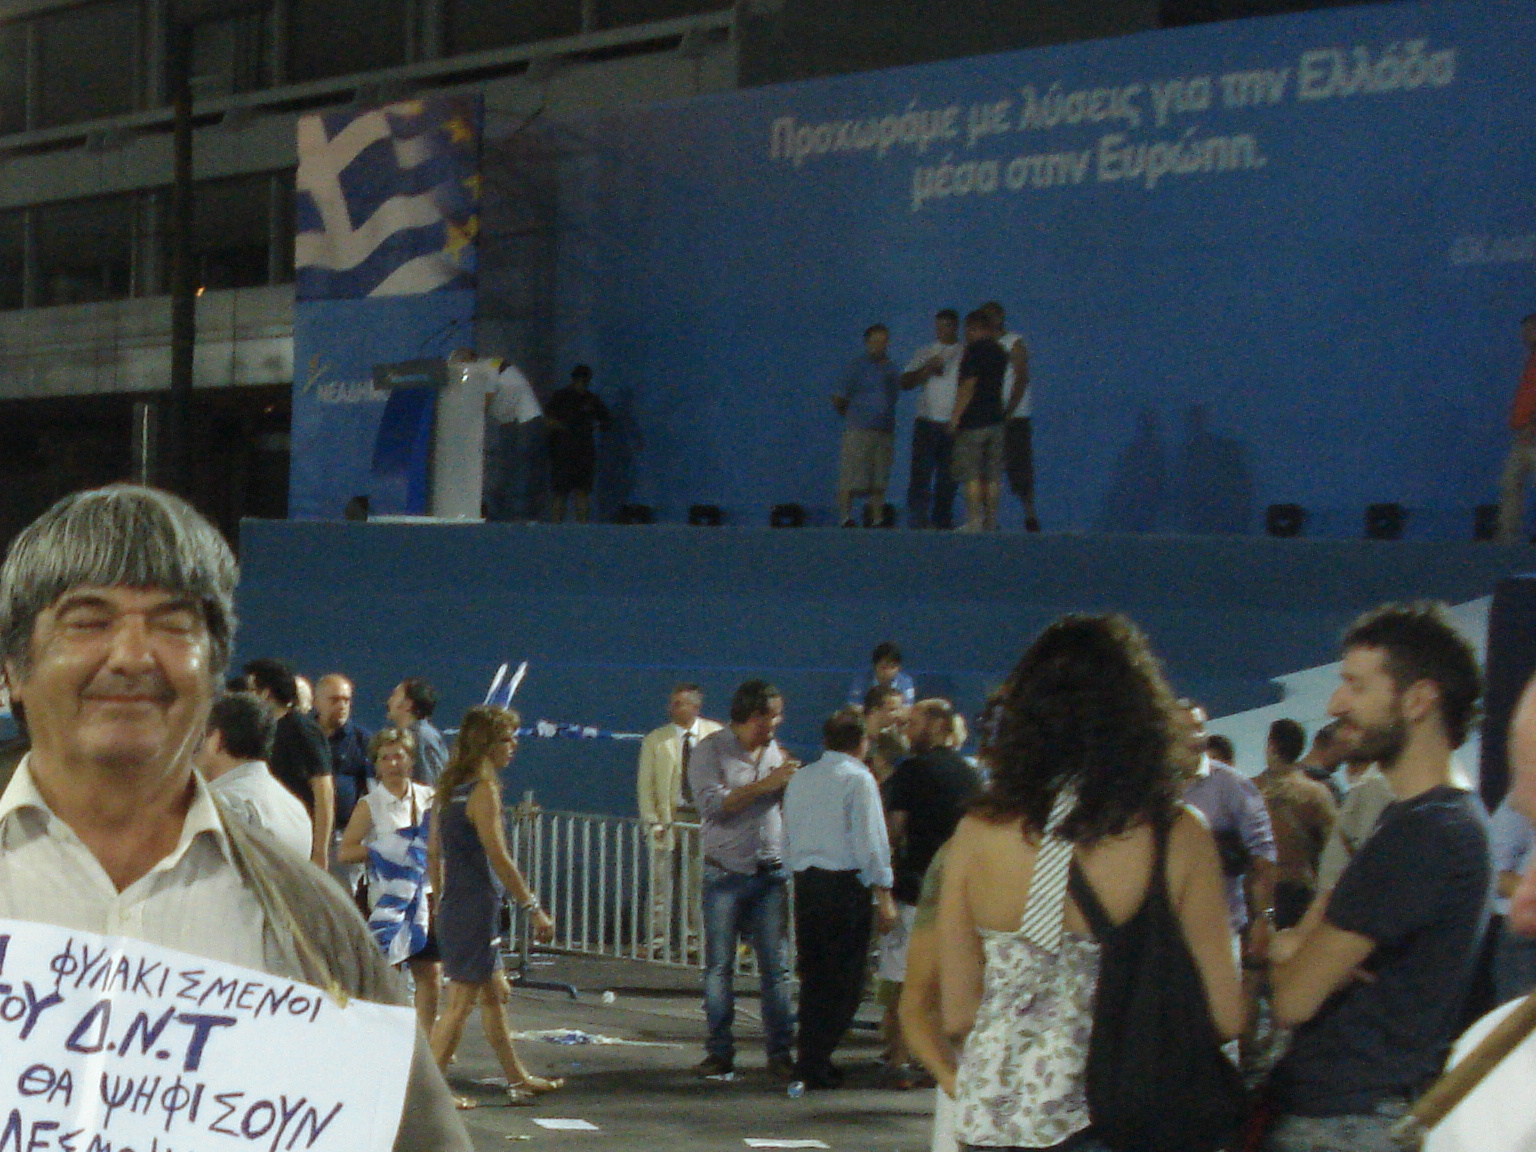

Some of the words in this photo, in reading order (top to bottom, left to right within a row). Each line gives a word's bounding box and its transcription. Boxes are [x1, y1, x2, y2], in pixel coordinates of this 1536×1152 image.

[769, 97, 959, 169] Προχωράμε
[967, 99, 1012, 149] με
[1020, 79, 1143, 129] λύσεις
[1150, 74, 1212, 128] για
[1218, 66, 1292, 109] την
[1297, 40, 1456, 101] Ελλάδα
[911, 151, 1000, 212] μέσα
[1005, 149, 1093, 190] στην
[17, 1063, 73, 1106] ΘΑ
